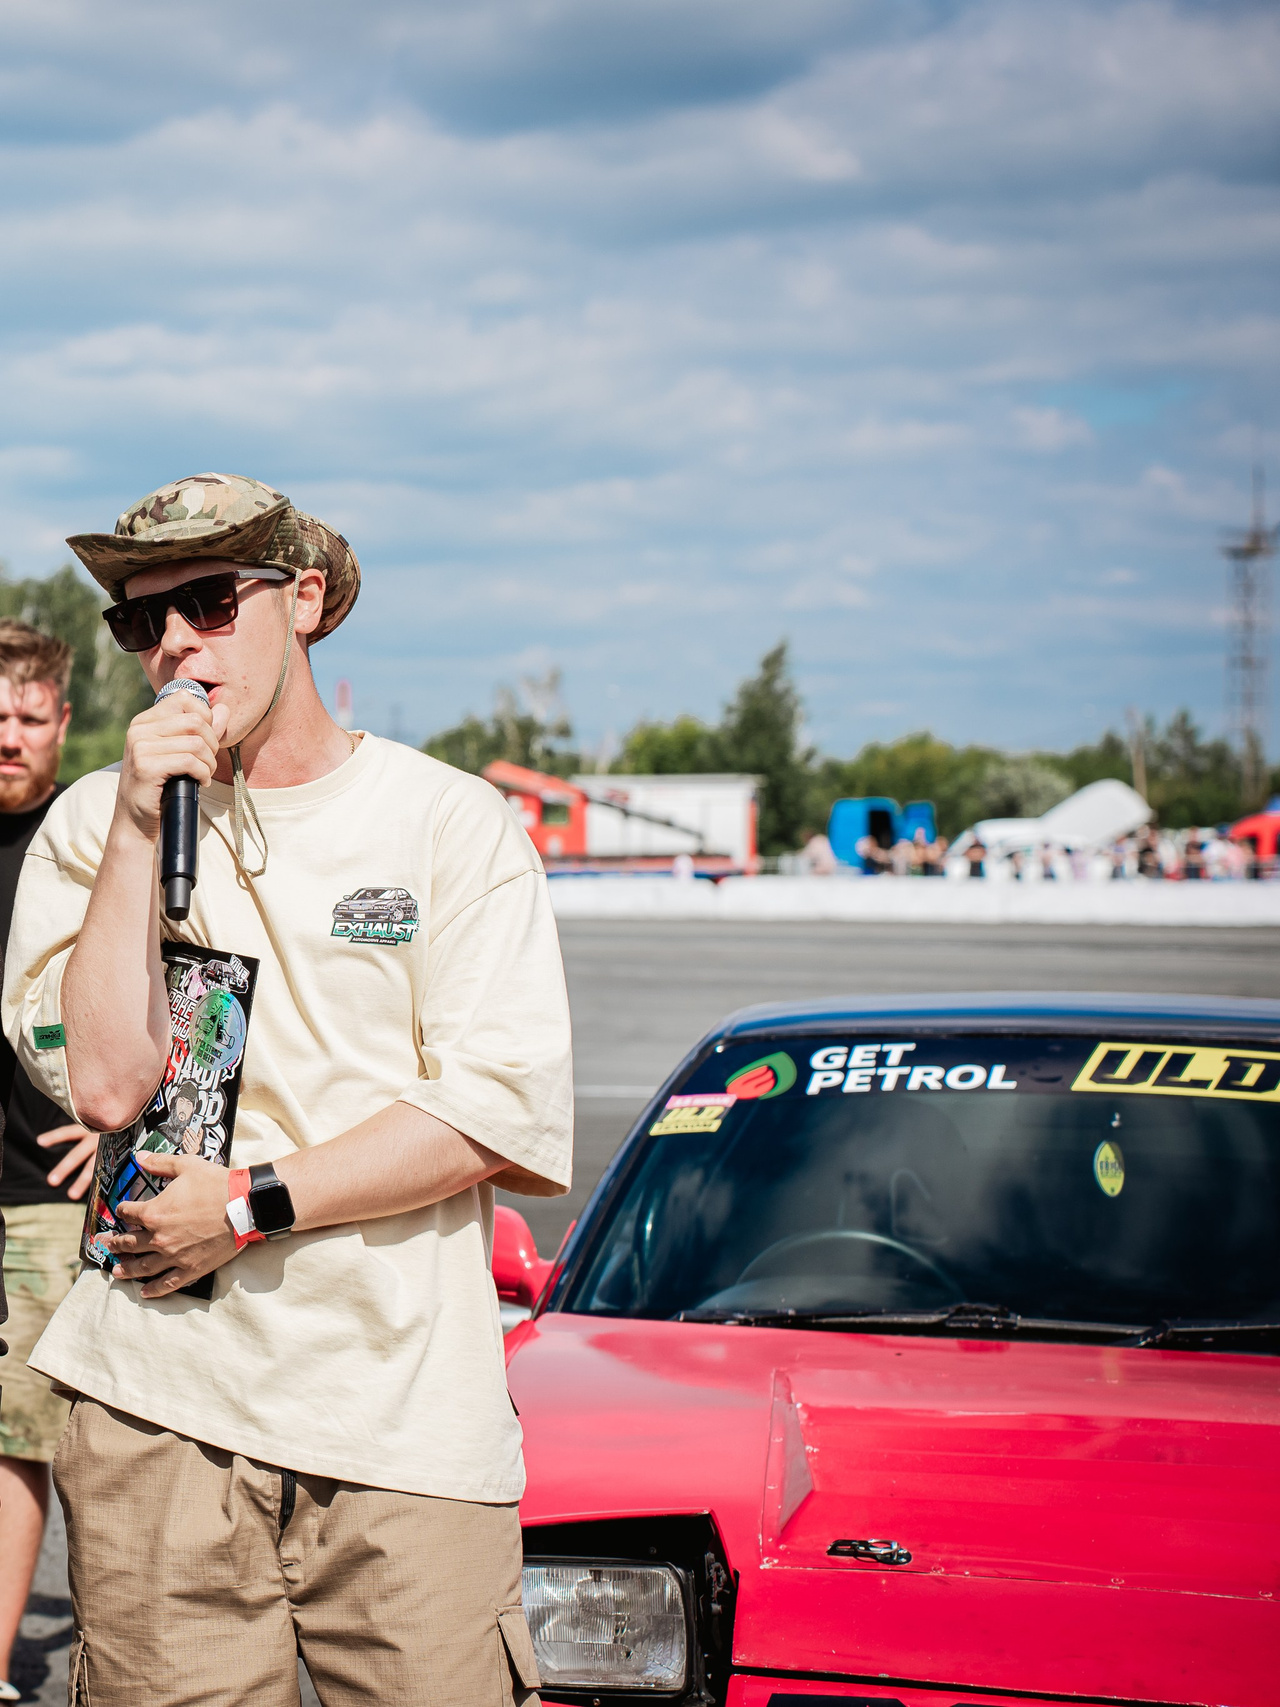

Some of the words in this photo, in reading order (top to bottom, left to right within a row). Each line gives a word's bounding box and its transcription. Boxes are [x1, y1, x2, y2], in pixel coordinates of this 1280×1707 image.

[334, 921, 415, 940] EXHAUST
[809, 1042, 917, 1071] GET
[1089, 1048, 1280, 1094] ULD
[805, 1064, 1018, 1096] PETROL
